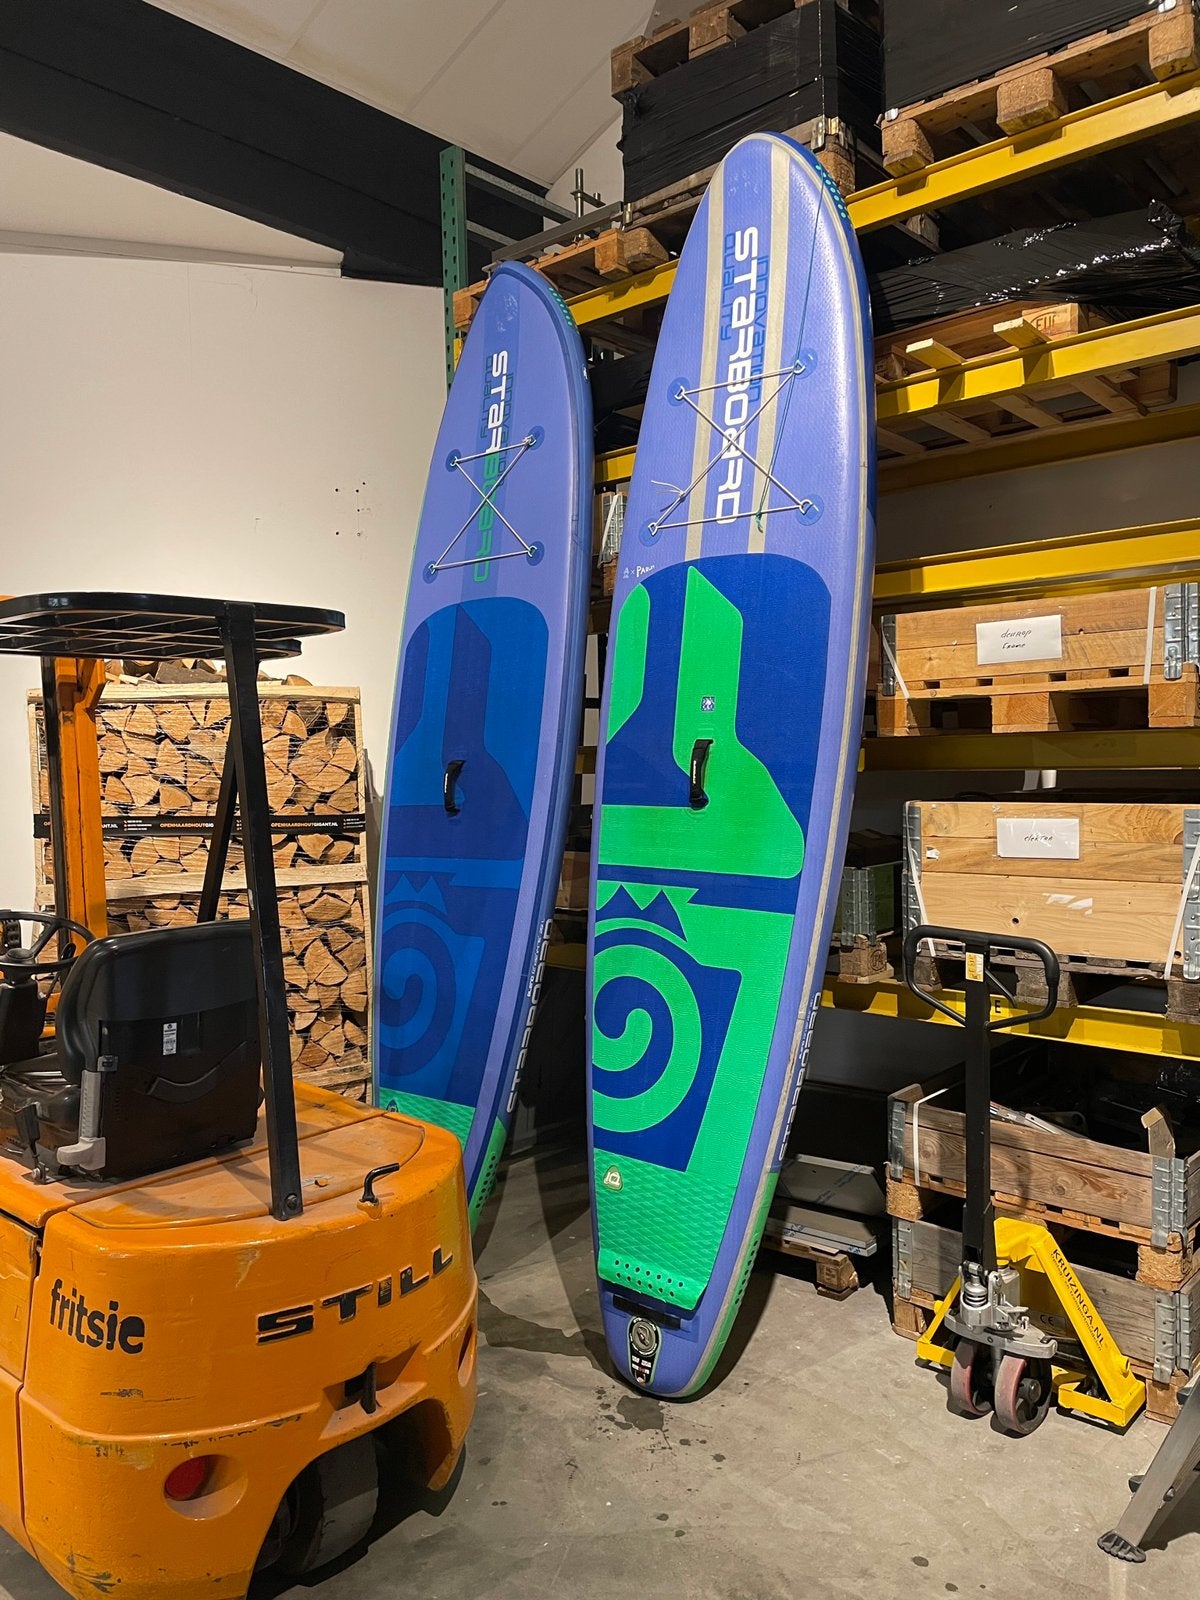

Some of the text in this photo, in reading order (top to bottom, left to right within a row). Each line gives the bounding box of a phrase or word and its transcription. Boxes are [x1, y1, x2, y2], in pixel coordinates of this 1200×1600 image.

[50, 1278, 146, 1355] fritsie
[255, 1244, 454, 1346] STILL
[1053, 1249, 1104, 1346] KRUIZINGA.NL
